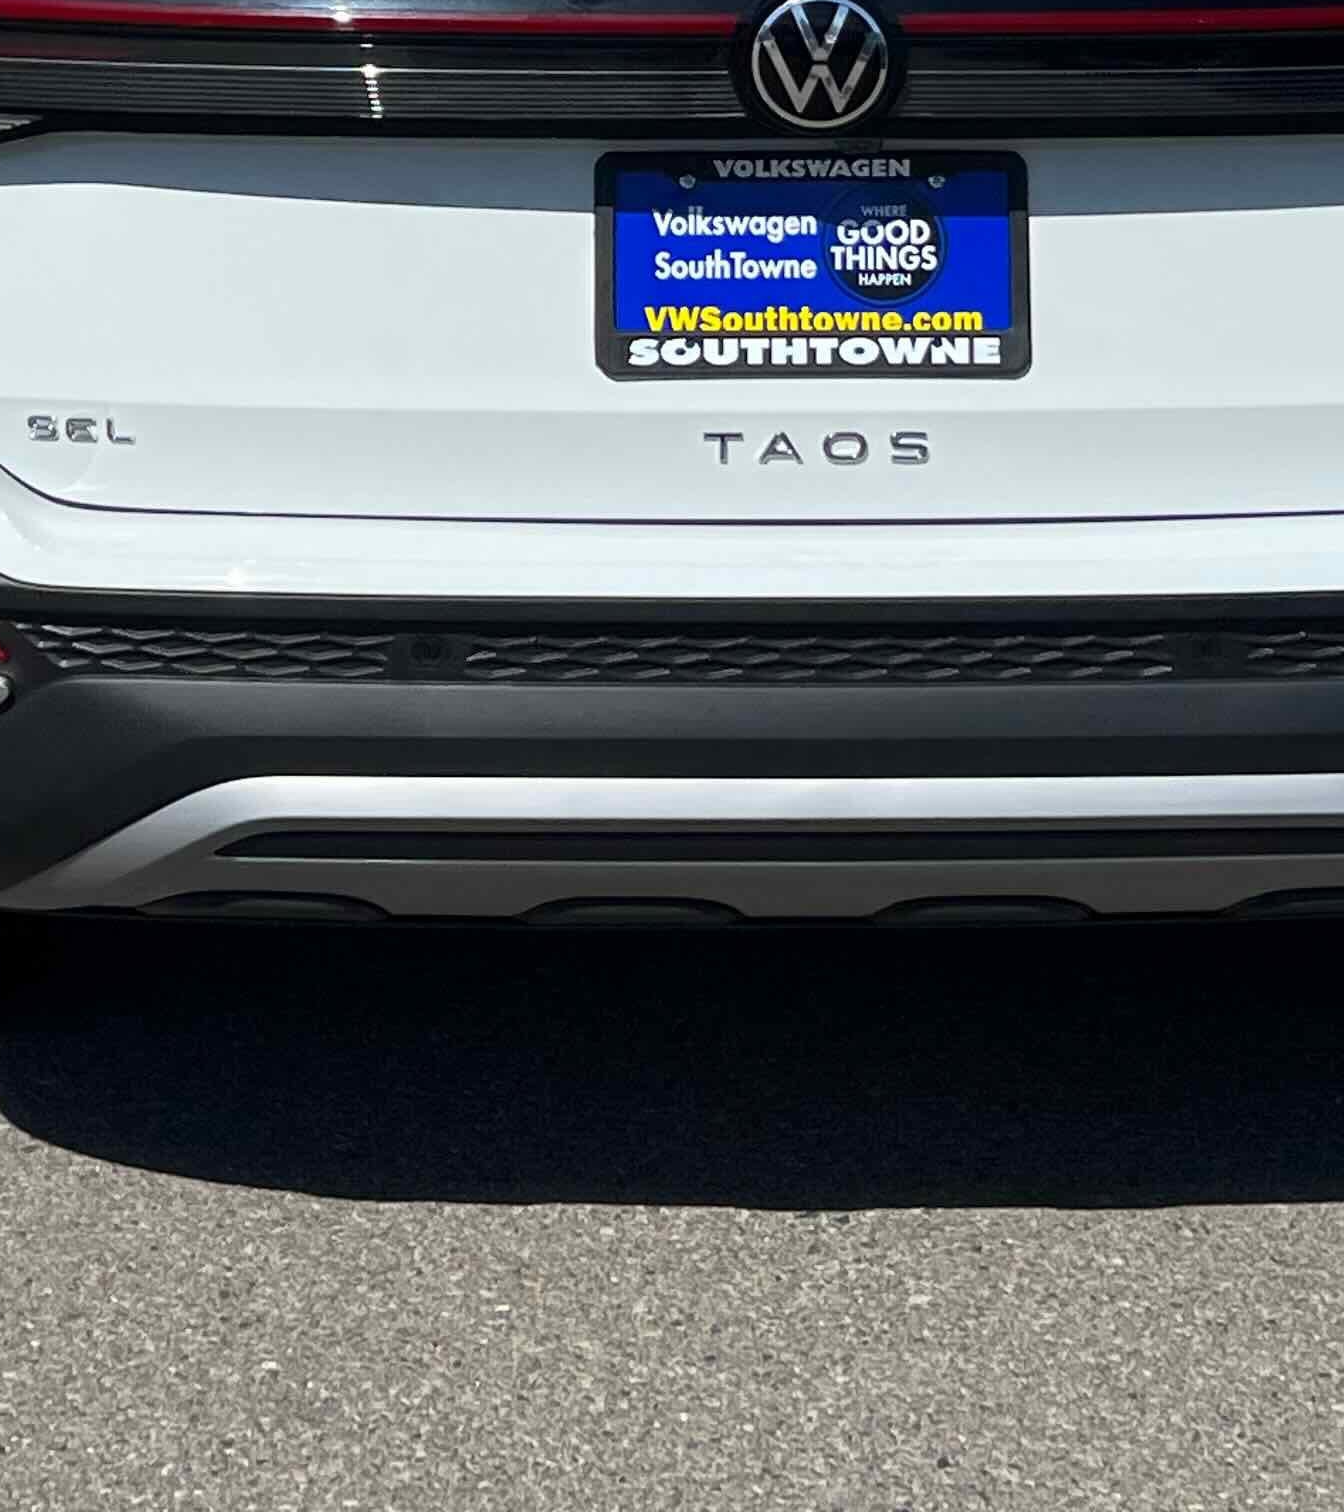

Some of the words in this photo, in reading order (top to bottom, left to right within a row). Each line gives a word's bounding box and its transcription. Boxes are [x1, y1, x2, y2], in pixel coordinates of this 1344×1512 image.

[712, 158, 911, 178] VOLKSWAGEN
[860, 204, 907, 216] WHERE
[652, 206, 818, 243] Volkswagen
[836, 219, 931, 245] GOOD
[654, 249, 818, 280] SouthTowne
[830, 245, 938, 271] THINGS
[858, 273, 912, 286] HAPPEN
[644, 306, 984, 332] VWSouthtowne.com
[627, 337, 1001, 366] SOUTHTOWNE
[27, 415, 137, 444] SEL
[703, 431, 931, 466] TAOS
